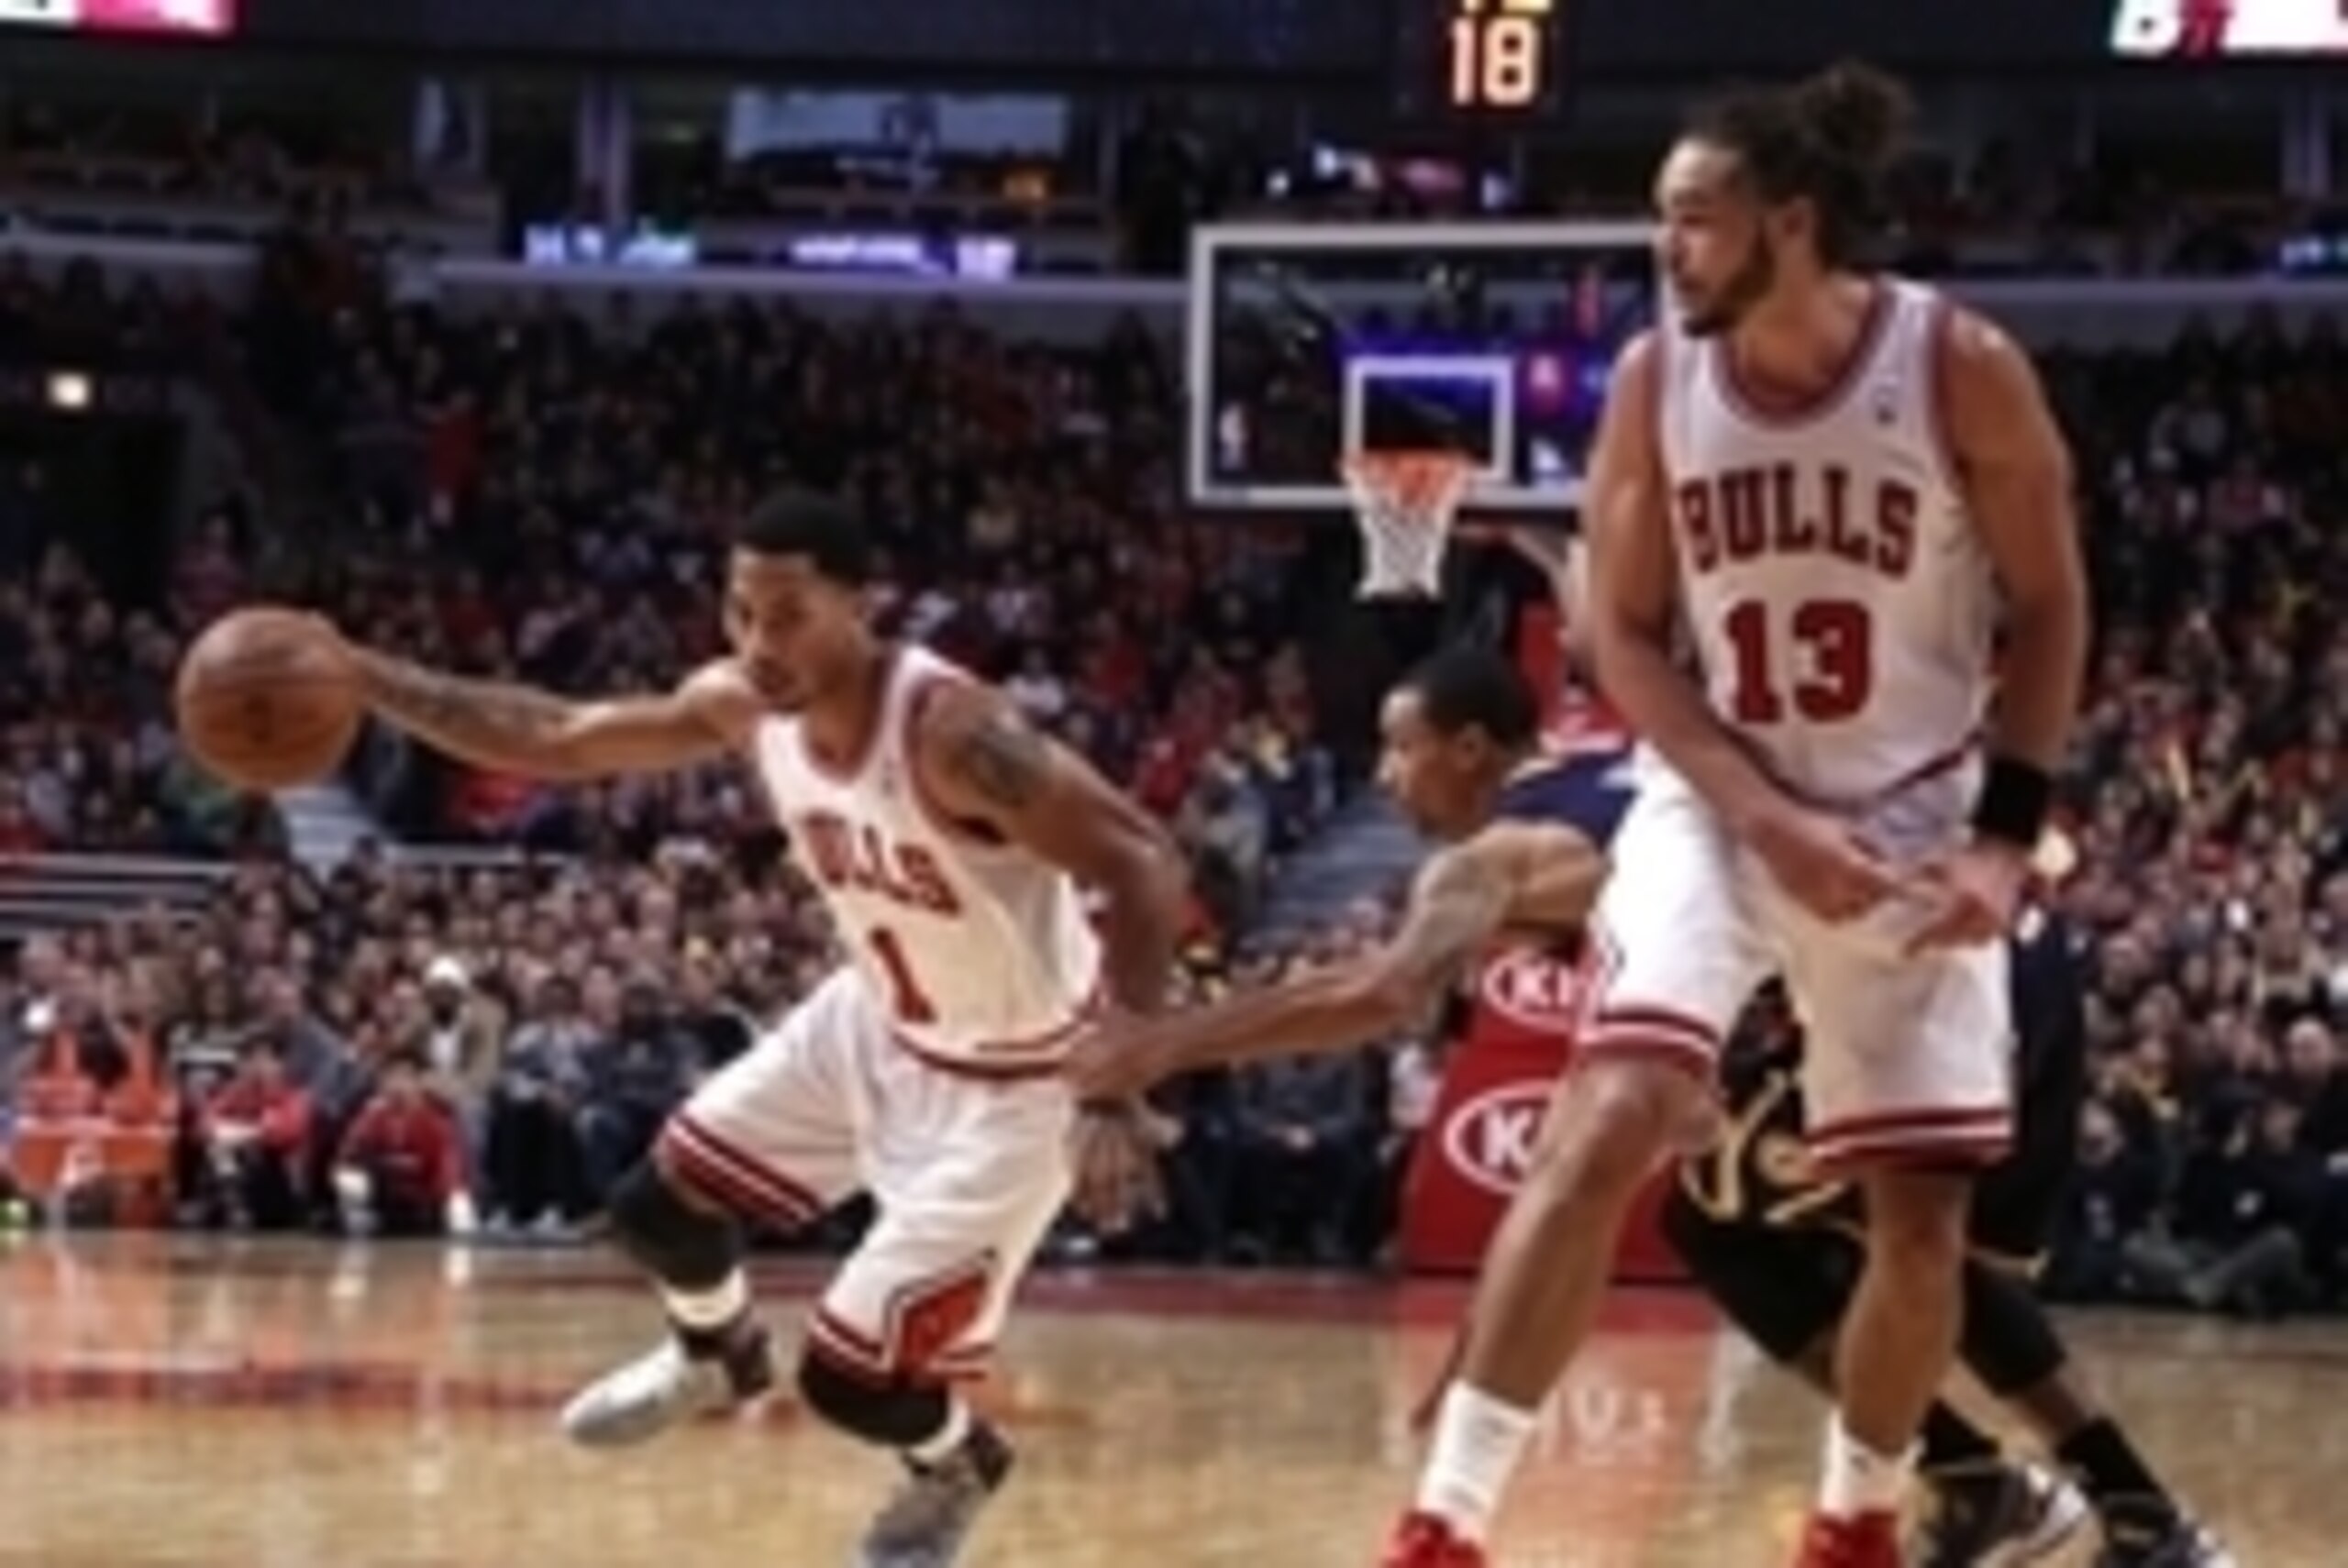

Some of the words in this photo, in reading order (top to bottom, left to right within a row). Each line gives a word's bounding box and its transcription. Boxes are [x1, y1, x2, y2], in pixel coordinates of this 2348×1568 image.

[1452, 17, 1541, 105] 18
[1679, 460, 1920, 581] BULLS
[1726, 600, 1873, 723] 13
[869, 927, 937, 1024] 1
[1512, 961, 1574, 1008] KI
